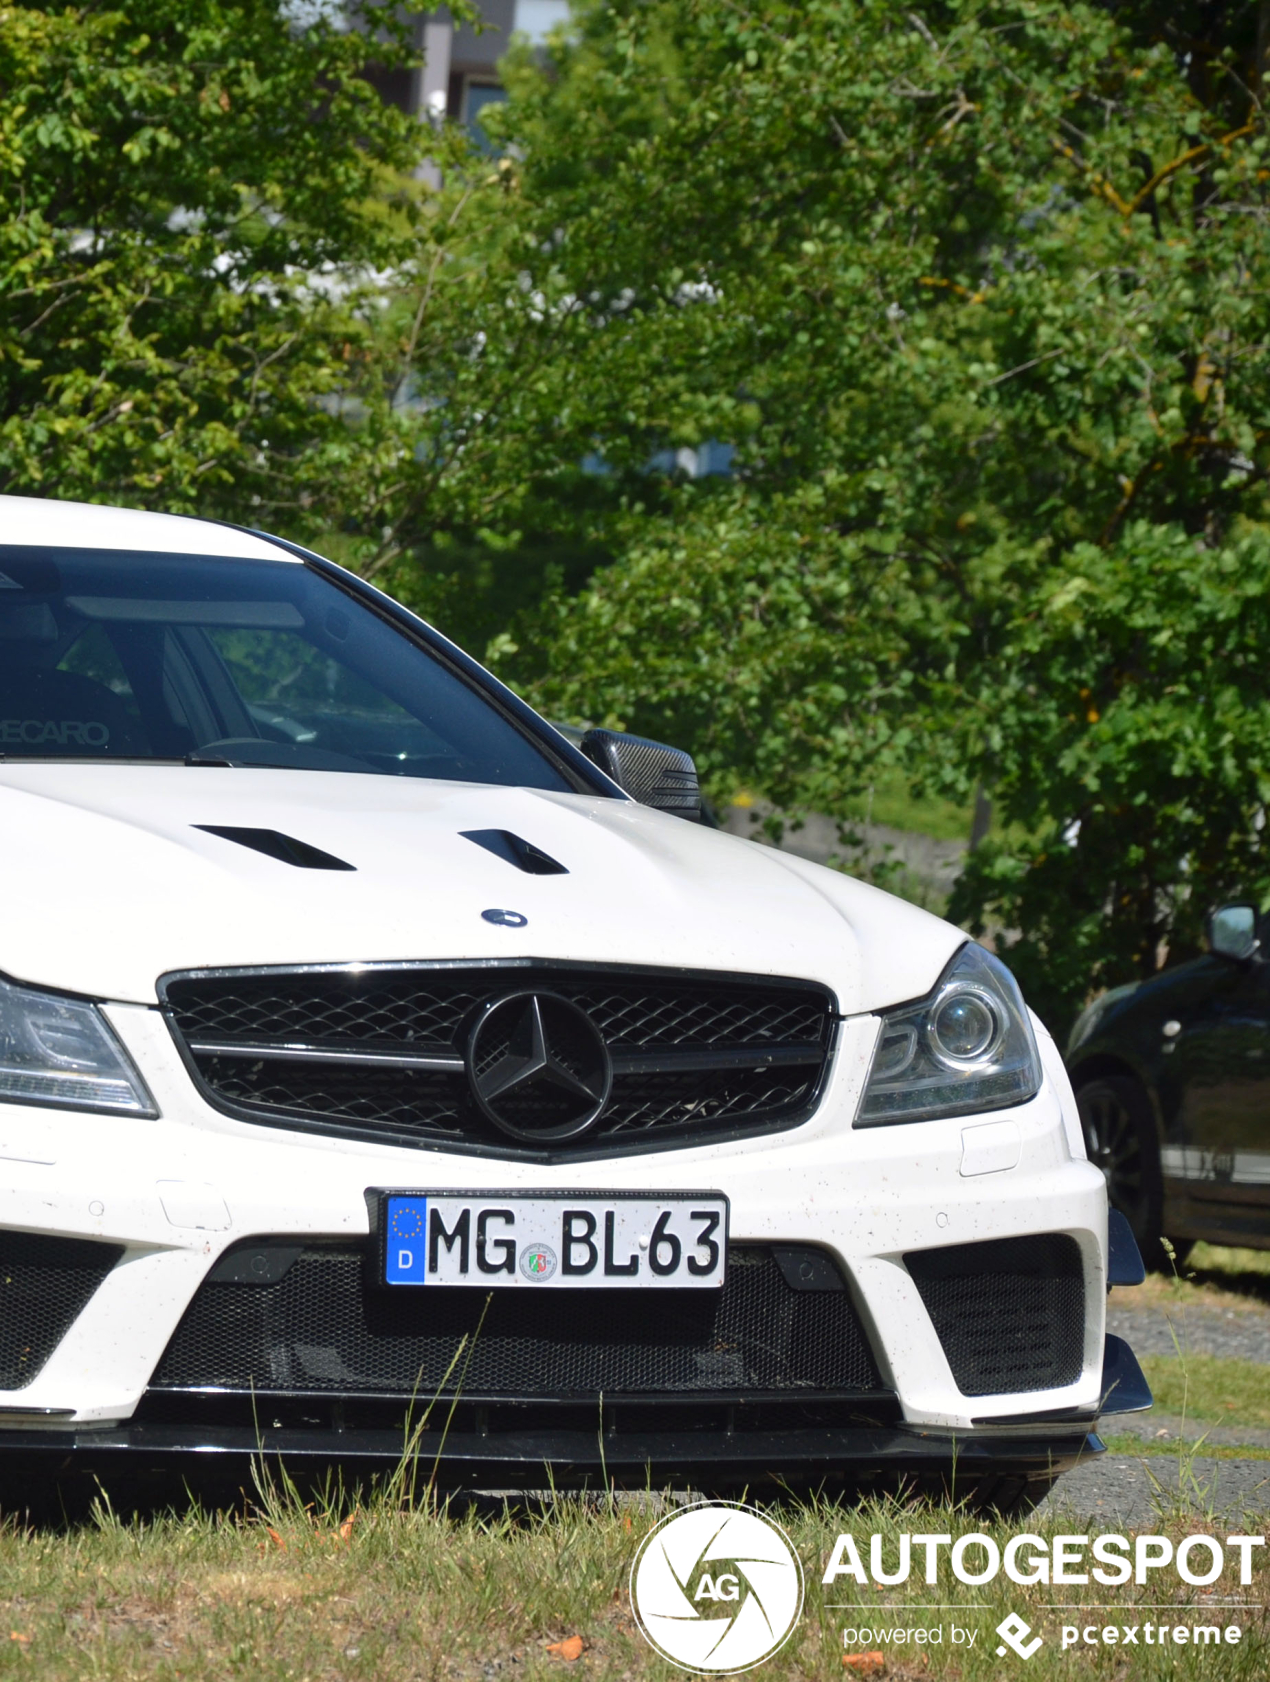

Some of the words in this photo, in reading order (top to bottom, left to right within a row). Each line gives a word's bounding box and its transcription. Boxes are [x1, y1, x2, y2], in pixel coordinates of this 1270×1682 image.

[398, 1251, 413, 1269] D
[429, 1208, 516, 1275] MG
[561, 1210, 720, 1277] BL63
